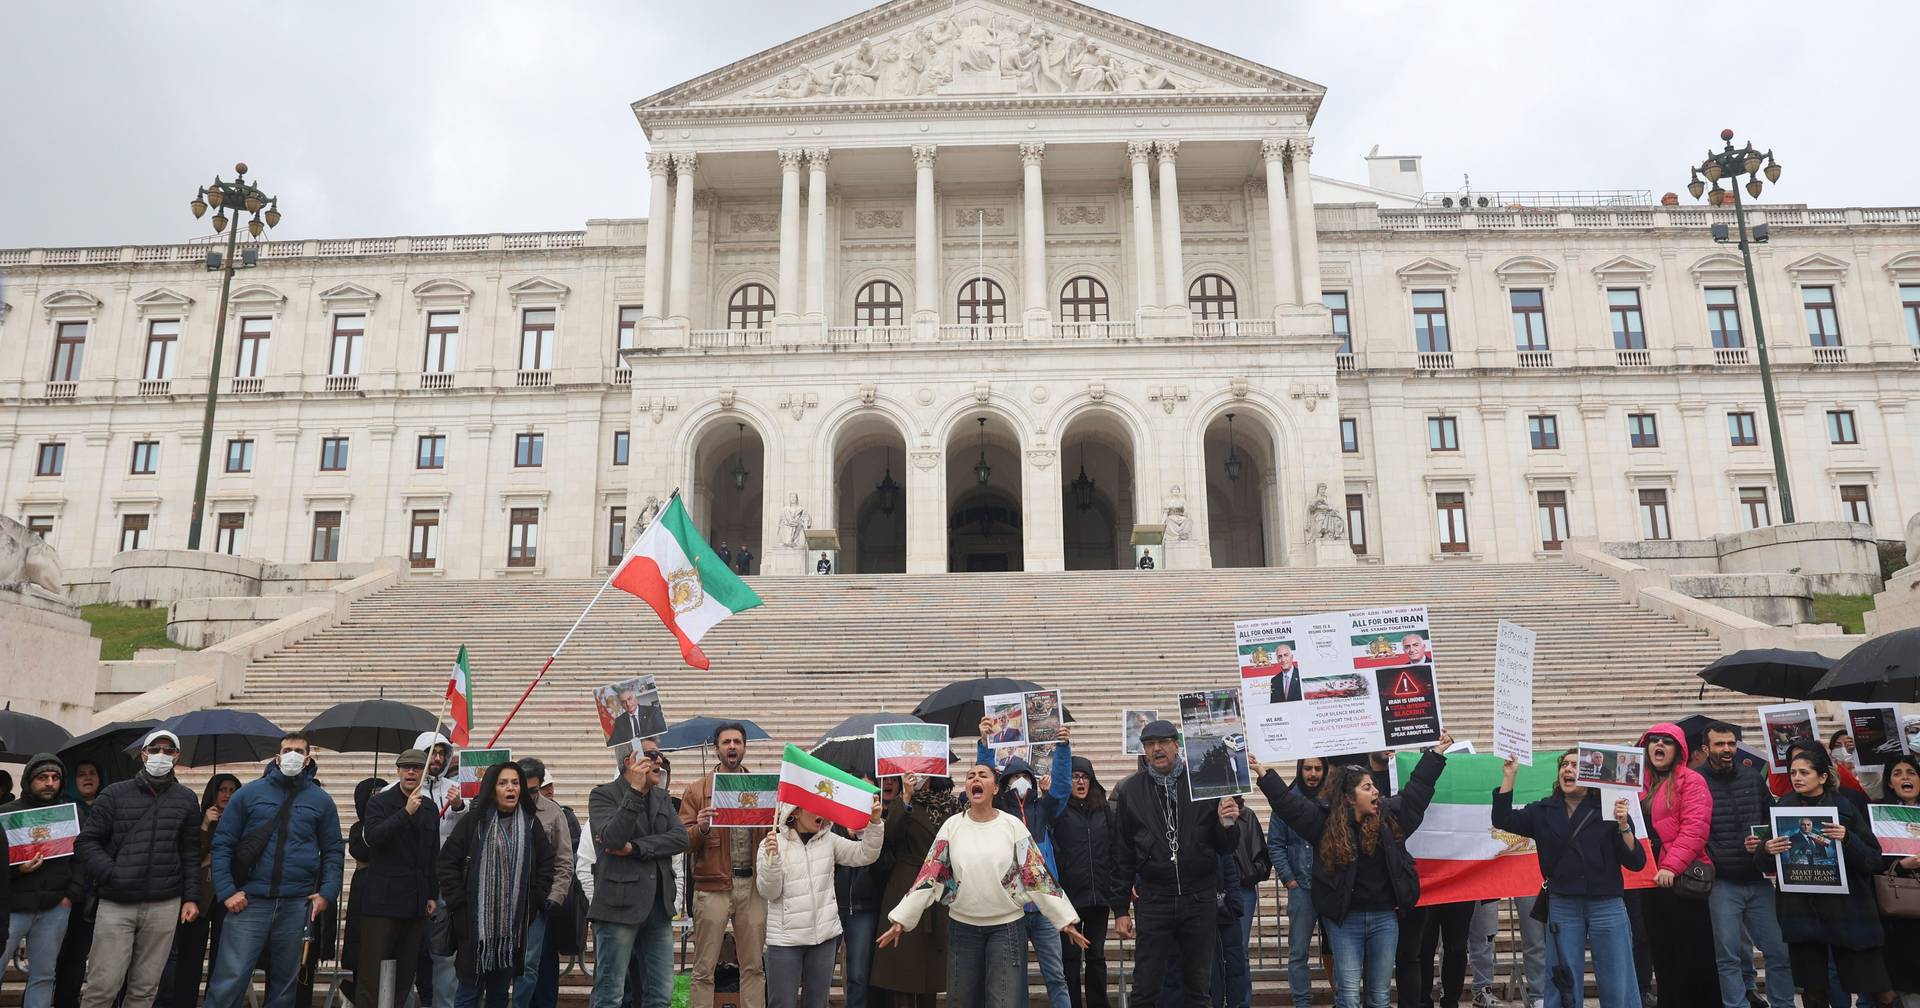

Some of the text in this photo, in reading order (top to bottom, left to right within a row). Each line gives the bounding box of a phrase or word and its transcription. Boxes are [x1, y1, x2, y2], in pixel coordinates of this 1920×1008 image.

[1352, 620, 1367, 628] ALL
[1401, 615, 1424, 623] IRAN
[1239, 626, 1292, 639] ALL FOR ONE IRAN
